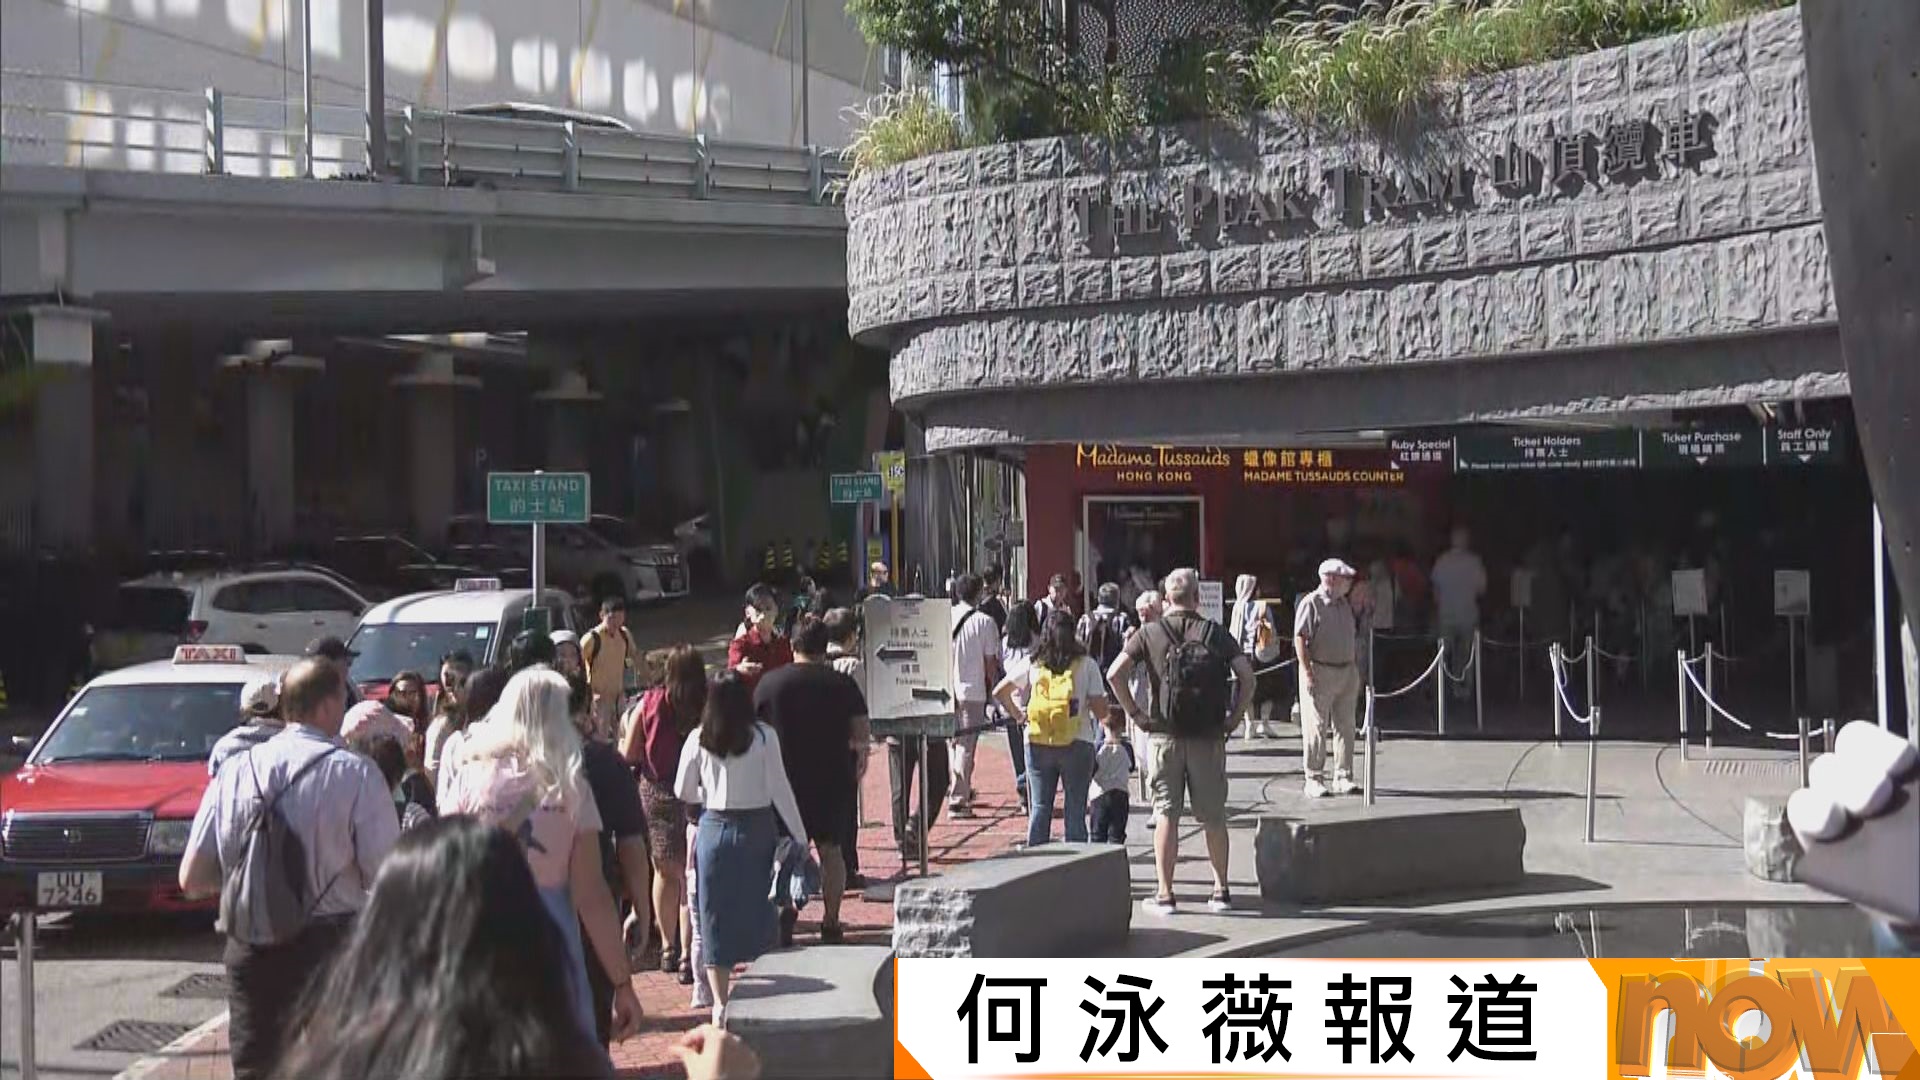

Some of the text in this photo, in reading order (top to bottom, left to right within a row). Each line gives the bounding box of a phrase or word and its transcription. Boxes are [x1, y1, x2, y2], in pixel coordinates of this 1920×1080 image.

[1491, 104, 1708, 188] 山頂纜車
[1072, 162, 1465, 237] THE PEAK TRAM
[1662, 431, 1741, 443] Ticket Purchase
[1777, 428, 1831, 440] Staff Only
[1391, 439, 1450, 451] Ruby Special
[1512, 436, 1582, 447] Ticket Holders
[1077, 441, 1231, 467] Madame Tussauds
[1117, 472, 1192, 481] HONG KONG
[1244, 471, 1404, 482] MADAME TUSSAUDS COUNTER
[495, 479, 579, 492] TAXI STAND
[510, 498, 565, 514] 的士站
[890, 627, 929, 638] 持票人士
[181, 647, 237, 660] TAXI
[57, 873, 84, 888] UU
[42, 887, 98, 906] 7246
